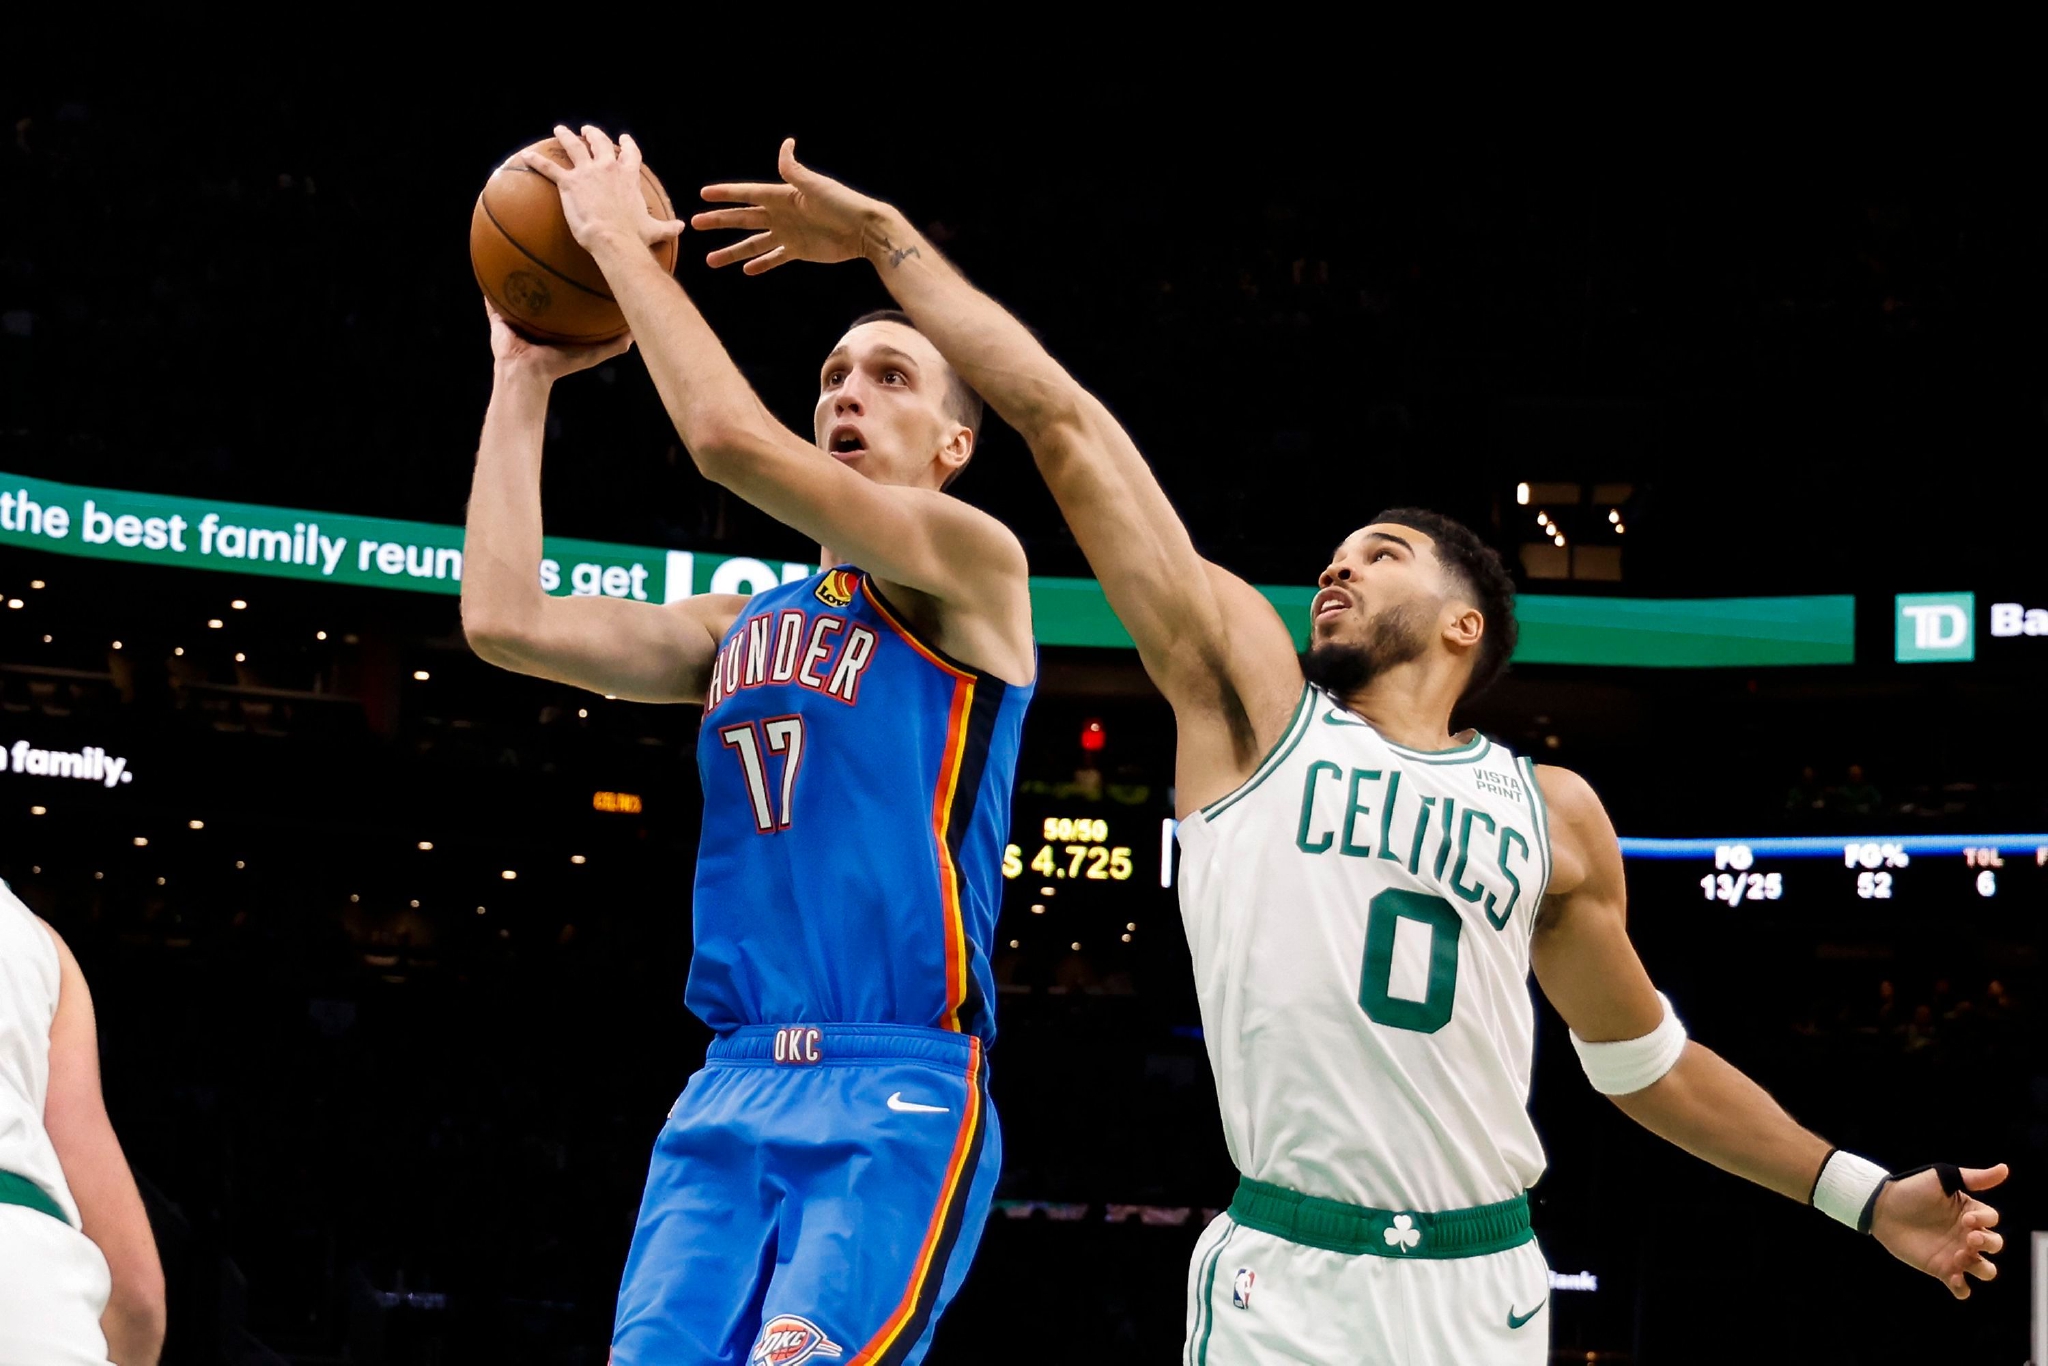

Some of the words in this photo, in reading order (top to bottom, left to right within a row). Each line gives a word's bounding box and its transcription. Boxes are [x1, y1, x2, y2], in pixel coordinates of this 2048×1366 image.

[0, 489, 70, 539] the
[82, 500, 188, 552] best
[198, 513, 347, 576] family
[571, 562, 649, 601] get
[1902, 604, 1968, 649] TD
[704, 608, 880, 717] HUNDER
[11, 740, 133, 788] family.
[718, 713, 806, 834] 17
[1472, 766, 1522, 792] VISTA
[1476, 780, 1522, 803] PRINT
[1043, 816, 1109, 843] 50/50
[1296, 760, 1530, 931] CELTICS
[1715, 844, 1754, 870] FG
[1844, 843, 1910, 869] FG%
[1700, 872, 1783, 908] 13/25
[1857, 871, 1893, 899] 52
[1976, 870, 1996, 897] 6
[1358, 886, 1462, 1034] 0
[774, 1028, 822, 1064] OKC
[755, 1330, 807, 1361] OKC
